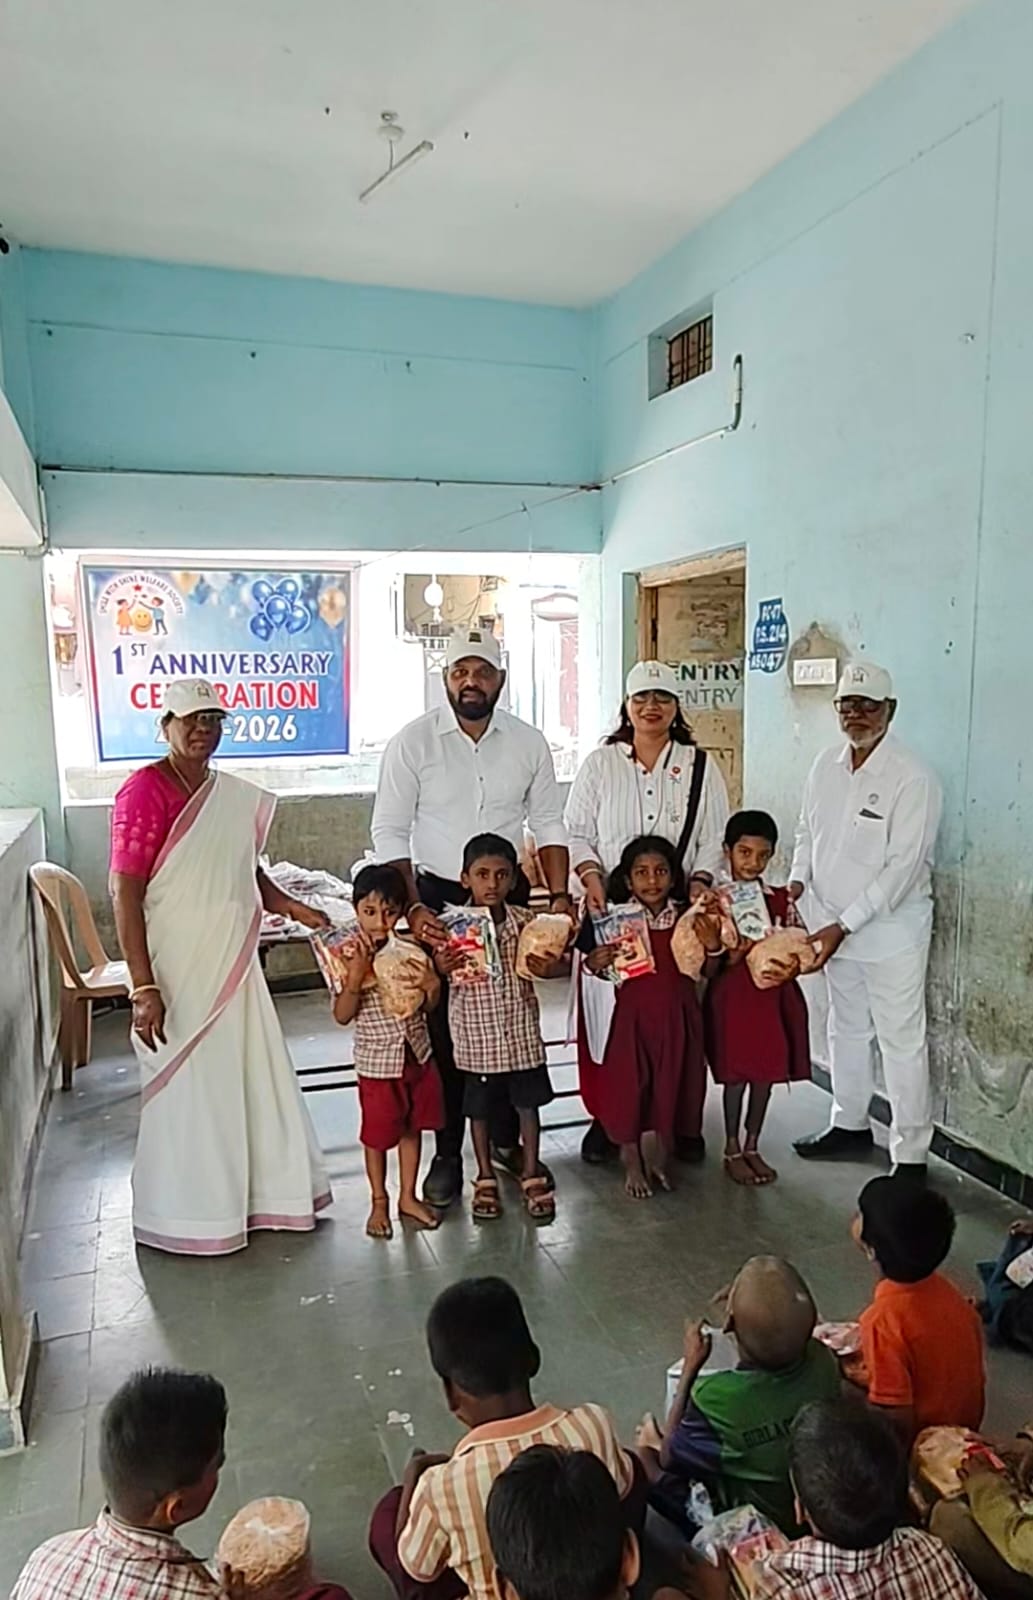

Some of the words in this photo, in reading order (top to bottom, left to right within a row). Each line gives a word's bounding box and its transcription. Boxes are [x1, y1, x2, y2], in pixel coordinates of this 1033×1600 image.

[150, 653, 331, 676] ANNIVERSARY
[130, 682, 318, 709] CERATION
[156, 714, 298, 743] 2-2026
